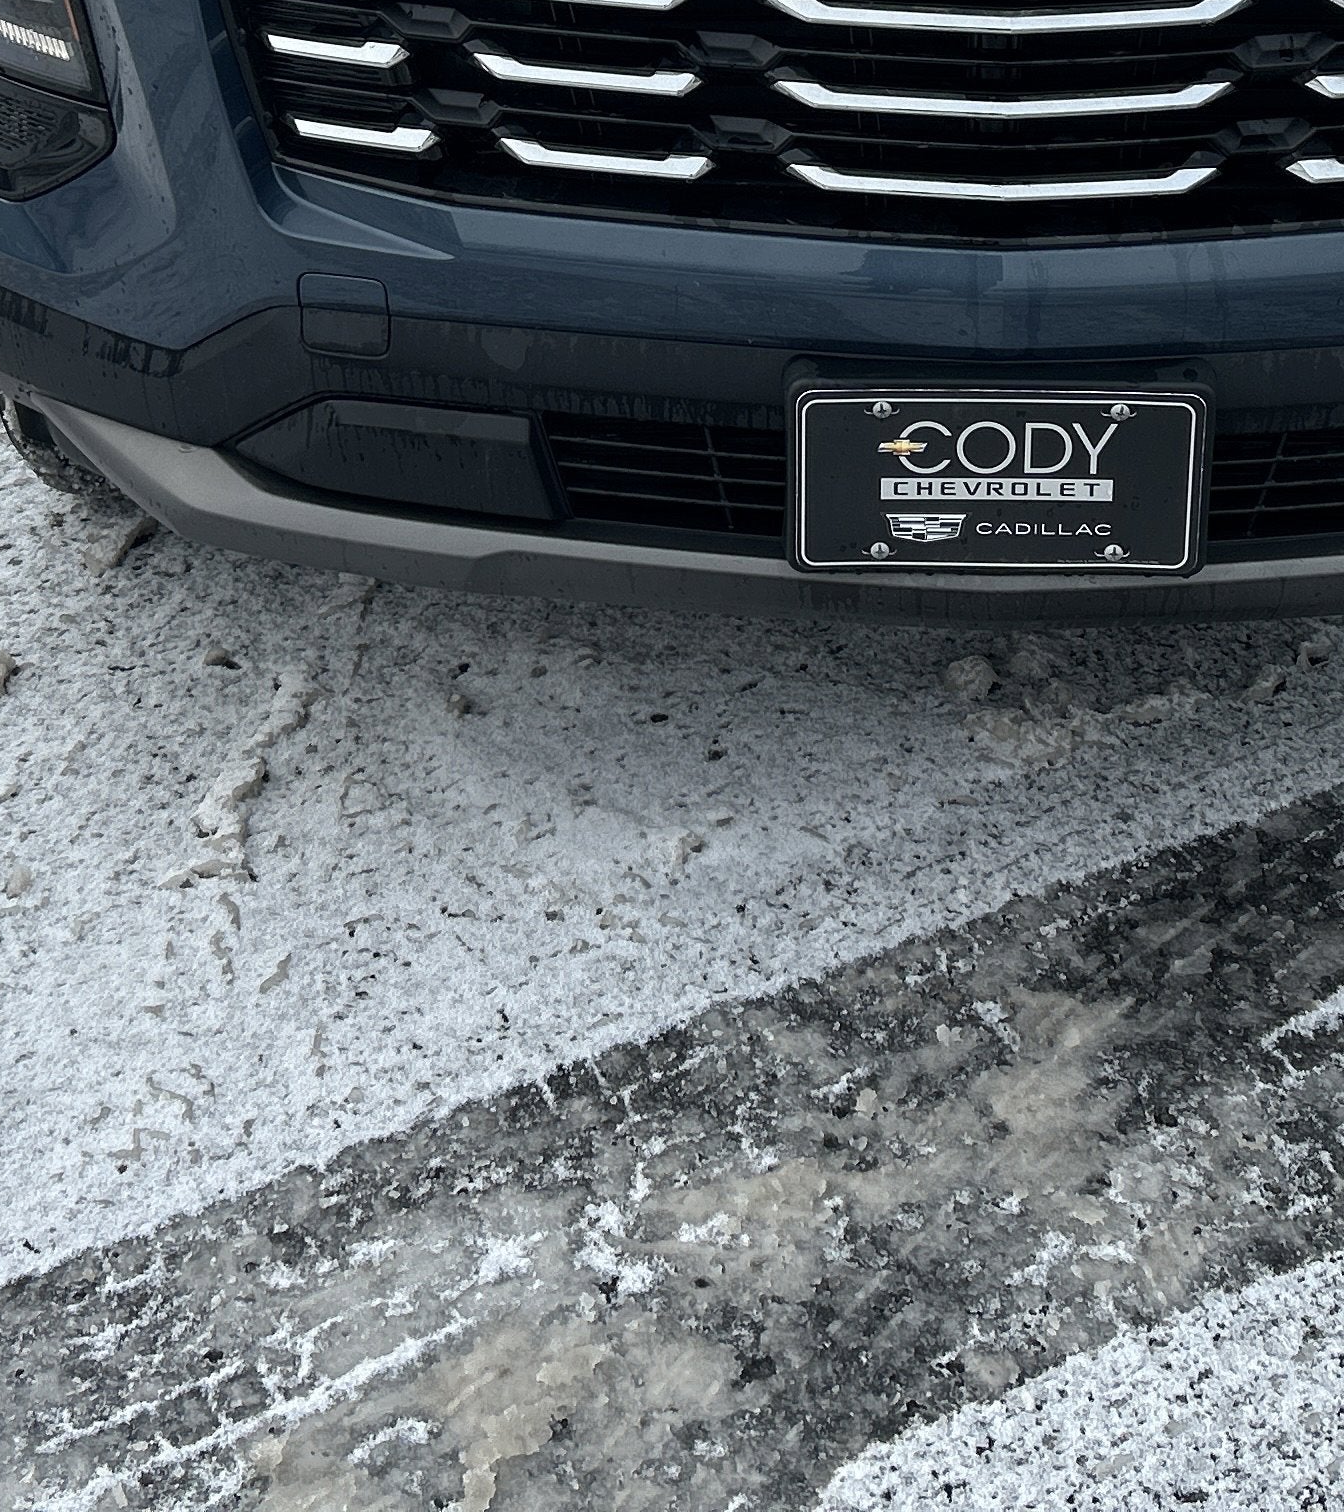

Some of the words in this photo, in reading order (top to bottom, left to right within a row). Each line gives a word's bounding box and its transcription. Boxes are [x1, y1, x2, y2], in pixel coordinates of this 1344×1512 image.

[896, 420, 1118, 475] CODY
[893, 481, 1101, 497] CHEVROLET
[975, 522, 1112, 537] CADILLAC
